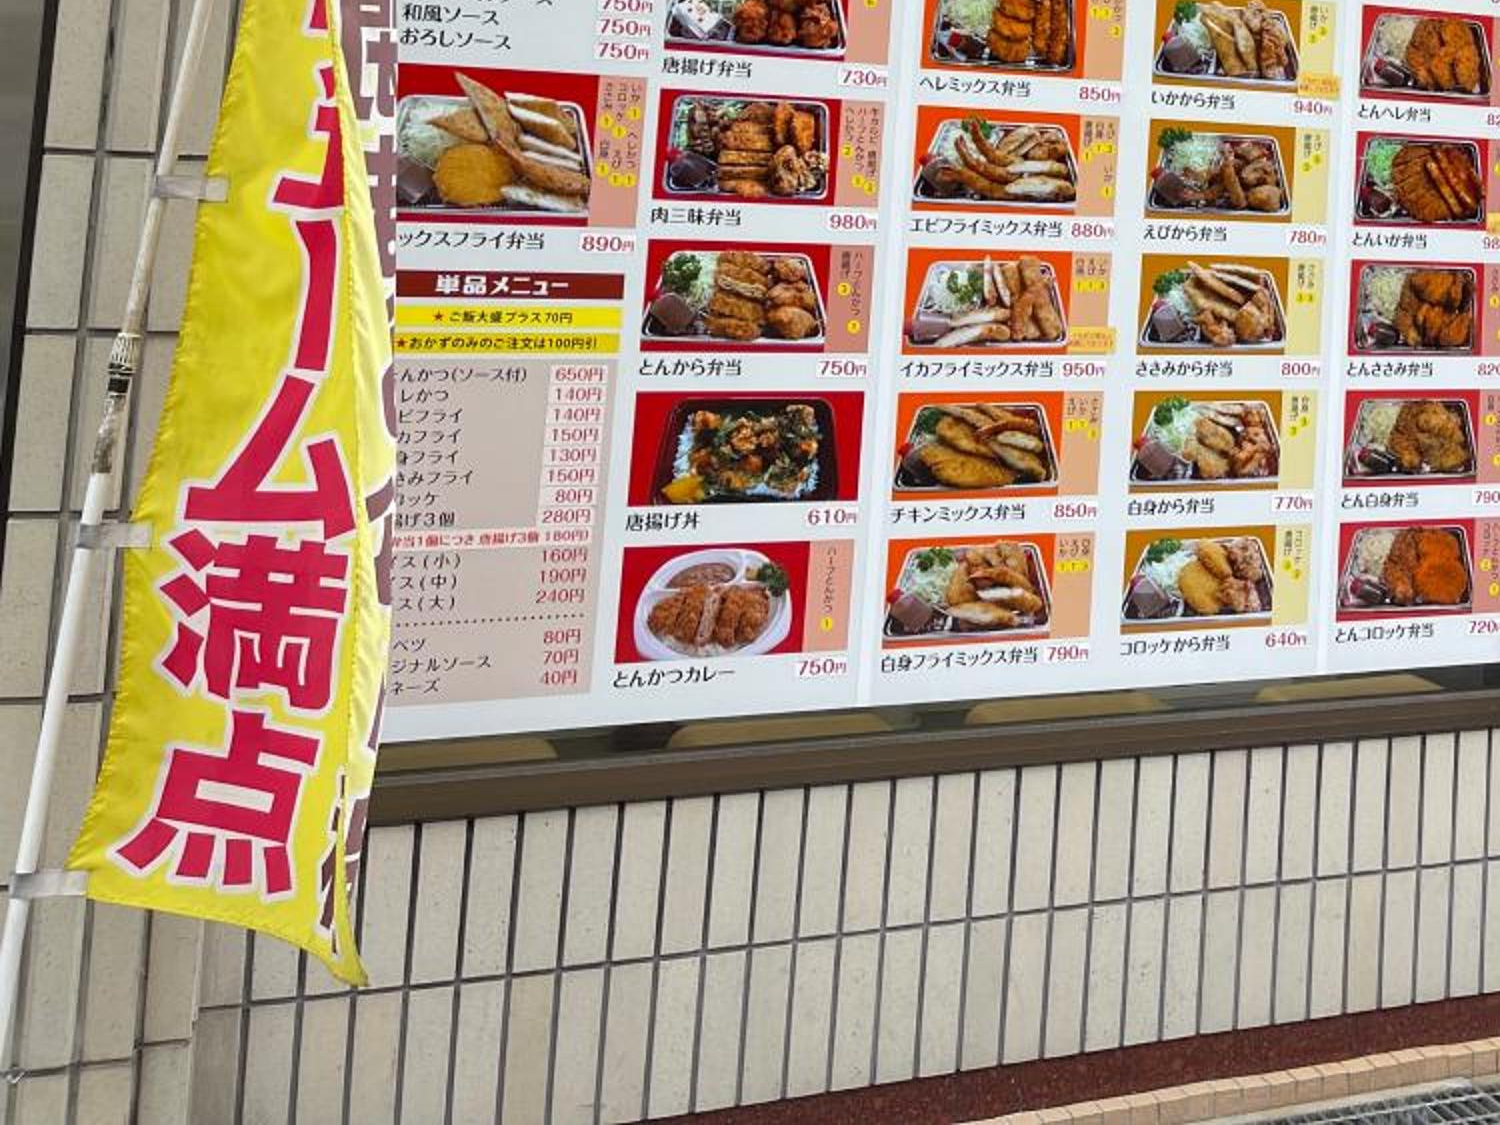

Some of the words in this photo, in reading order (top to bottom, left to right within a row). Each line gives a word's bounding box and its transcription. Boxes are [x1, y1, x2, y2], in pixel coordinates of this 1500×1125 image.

[402, 4, 501, 26] 和風ソース
[598, 19, 651, 37] 750円
[399, 28, 512, 50] おろしソース
[597, 43, 650, 61] 750円
[661, 56, 753, 79] 唐揚げ弁当
[840, 70, 887, 86] 730円
[1079, 85, 1121, 103] 850円
[1151, 91, 1236, 111] いかから弁当
[1293, 99, 1333, 116] 940円
[650, 205, 742, 227] 肉三昧弁当
[829, 214, 877, 230] 980円
[910, 217, 1062, 238] エビフライミックス弁当
[1071, 222, 1114, 238] 880円
[399, 230, 545, 250] ックスフライ弁当
[581, 235, 634, 252] 890円
[1144, 224, 1227, 243] えびから弁当
[1288, 229, 1327, 244] 780円
[435, 274, 569, 295] 単品メニュー
[400, 366, 527, 383] んかつ(ソース付)
[638, 357, 743, 378] とんから弁当
[819, 361, 867, 376] 750円
[900, 360, 1053, 378] イカフライミックス弁当
[1062, 362, 1105, 377] 950円
[1135, 360, 1233, 378] ささみから弁当
[1281, 362, 1320, 376] 800円
[401, 389, 449, 402] レかつ
[399, 408, 463, 423] ビフライ
[397, 429, 462, 444] カフライ
[891, 503, 1025, 524] チキンミックス弁当
[1053, 503, 1097, 518] 850円
[1127, 496, 1215, 517] 白身から弁当
[1273, 496, 1313, 511] 770円
[624, 510, 700, 533] 唐揚げ丼
[806, 508, 858, 525] 610円
[1120, 635, 1230, 656] コロッケから弁当
[1264, 631, 1307, 647] 640円
[391, 655, 492, 674] ジナルソース
[881, 647, 1038, 673] 白身フライミックス弁当
[1046, 646, 1088, 662] 790円
[612, 666, 735, 689] とんかつカレー
[798, 658, 847, 675] 750円
